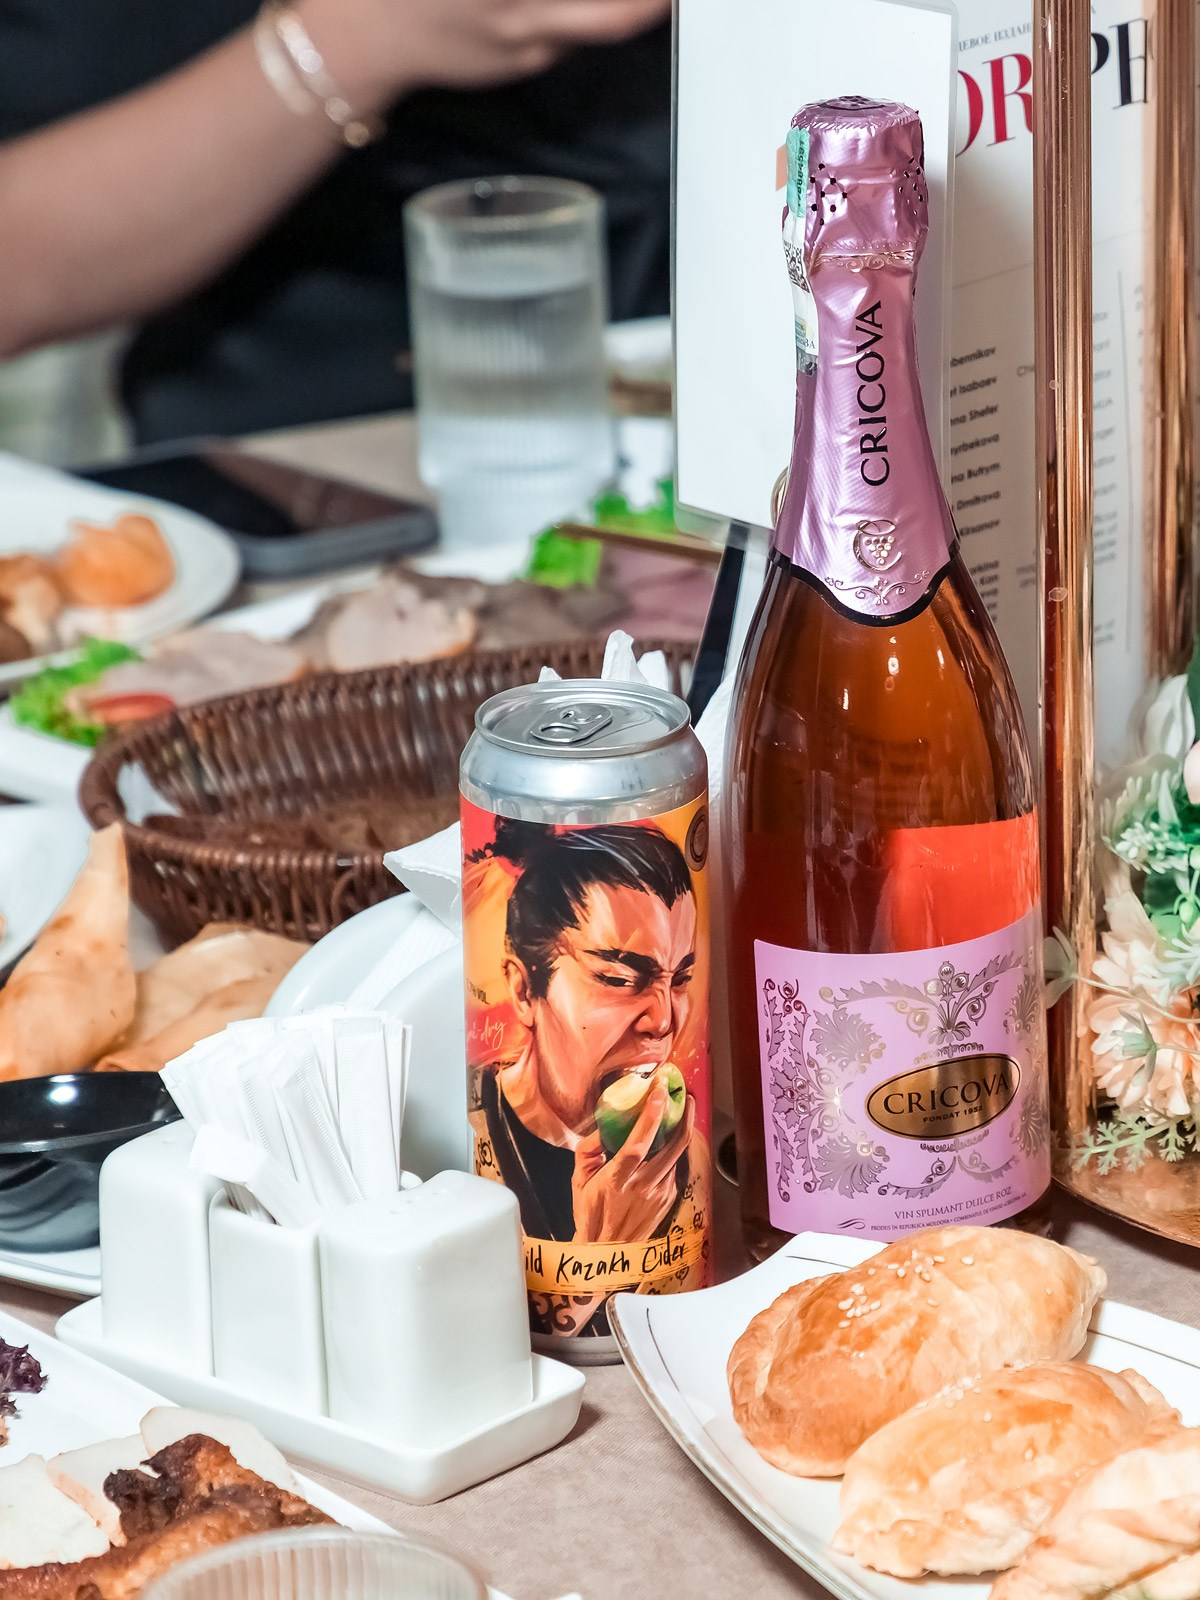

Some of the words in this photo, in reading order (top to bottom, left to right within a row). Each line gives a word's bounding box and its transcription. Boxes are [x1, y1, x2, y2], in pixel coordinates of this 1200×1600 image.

[855, 300, 890, 487] CRICOVA
[883, 1072, 1010, 1115] CRICOVA
[923, 1111, 960, 1123] FONDAT
[895, 1210, 914, 1220] VIN
[916, 1202, 964, 1218] SPUMANT
[965, 1193, 995, 1210] DULCE
[996, 1186, 1012, 1200] ROZ
[556, 1252, 630, 1284] Kazakh
[642, 1234, 687, 1274] Cider
